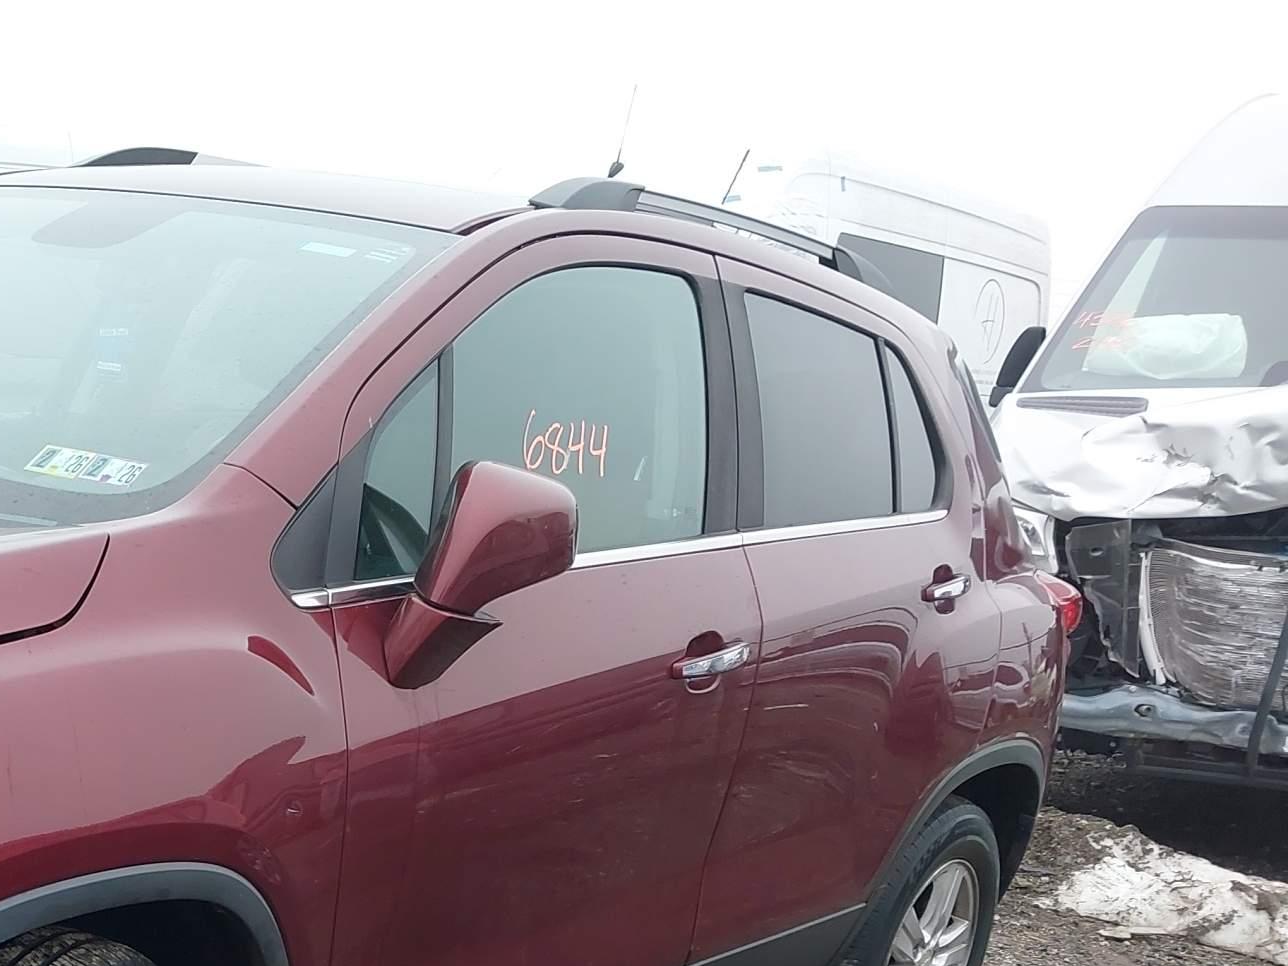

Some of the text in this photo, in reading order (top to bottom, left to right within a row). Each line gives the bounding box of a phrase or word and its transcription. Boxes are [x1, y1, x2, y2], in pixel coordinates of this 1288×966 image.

[523, 409, 608, 477] 6844
[65, 454, 90, 473] 26
[117, 464, 143, 484] 26
